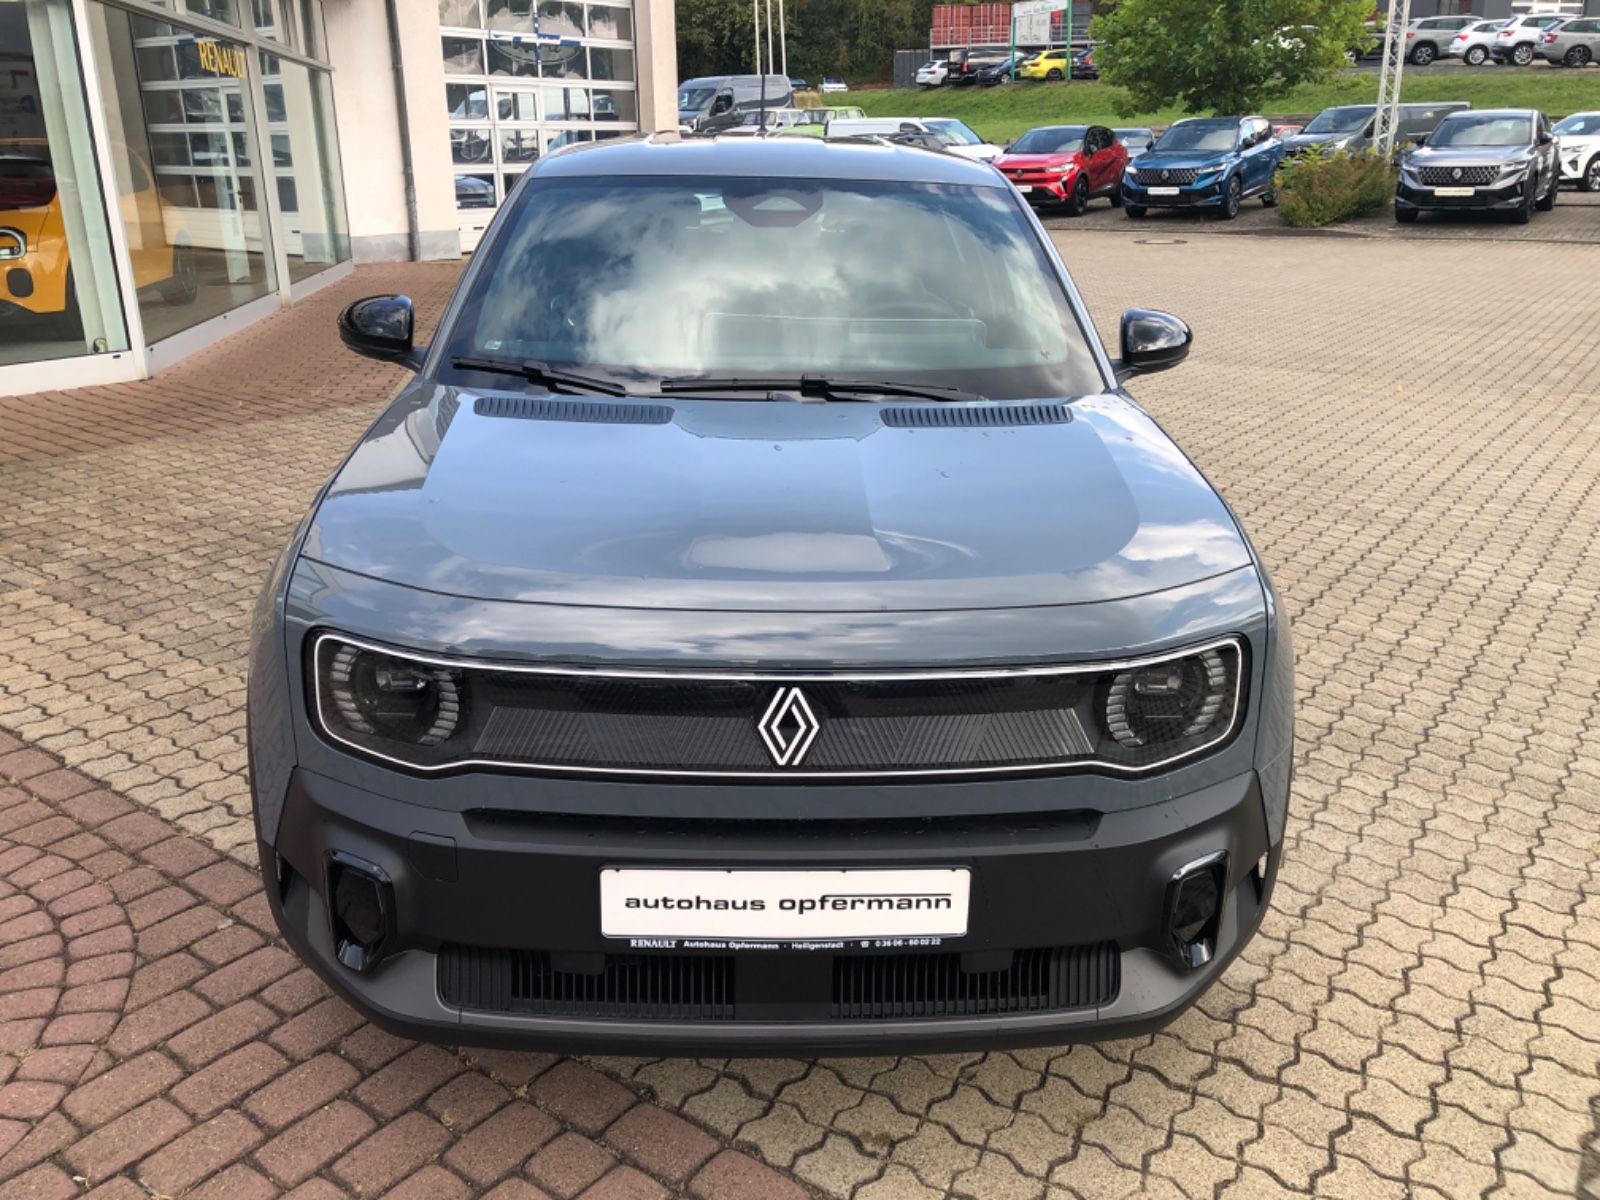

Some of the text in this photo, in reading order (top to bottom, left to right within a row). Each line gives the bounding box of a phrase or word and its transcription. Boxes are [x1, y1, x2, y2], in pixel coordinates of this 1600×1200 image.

[197, 39, 247, 78] RENAULT
[624, 893, 952, 915] autohaus opfermann
[630, 939, 677, 949] RENAULT
[683, 940, 726, 949] Autohaus
[728, 941, 779, 950] Opfermann
[791, 942, 844, 951] Heiligenstadt
